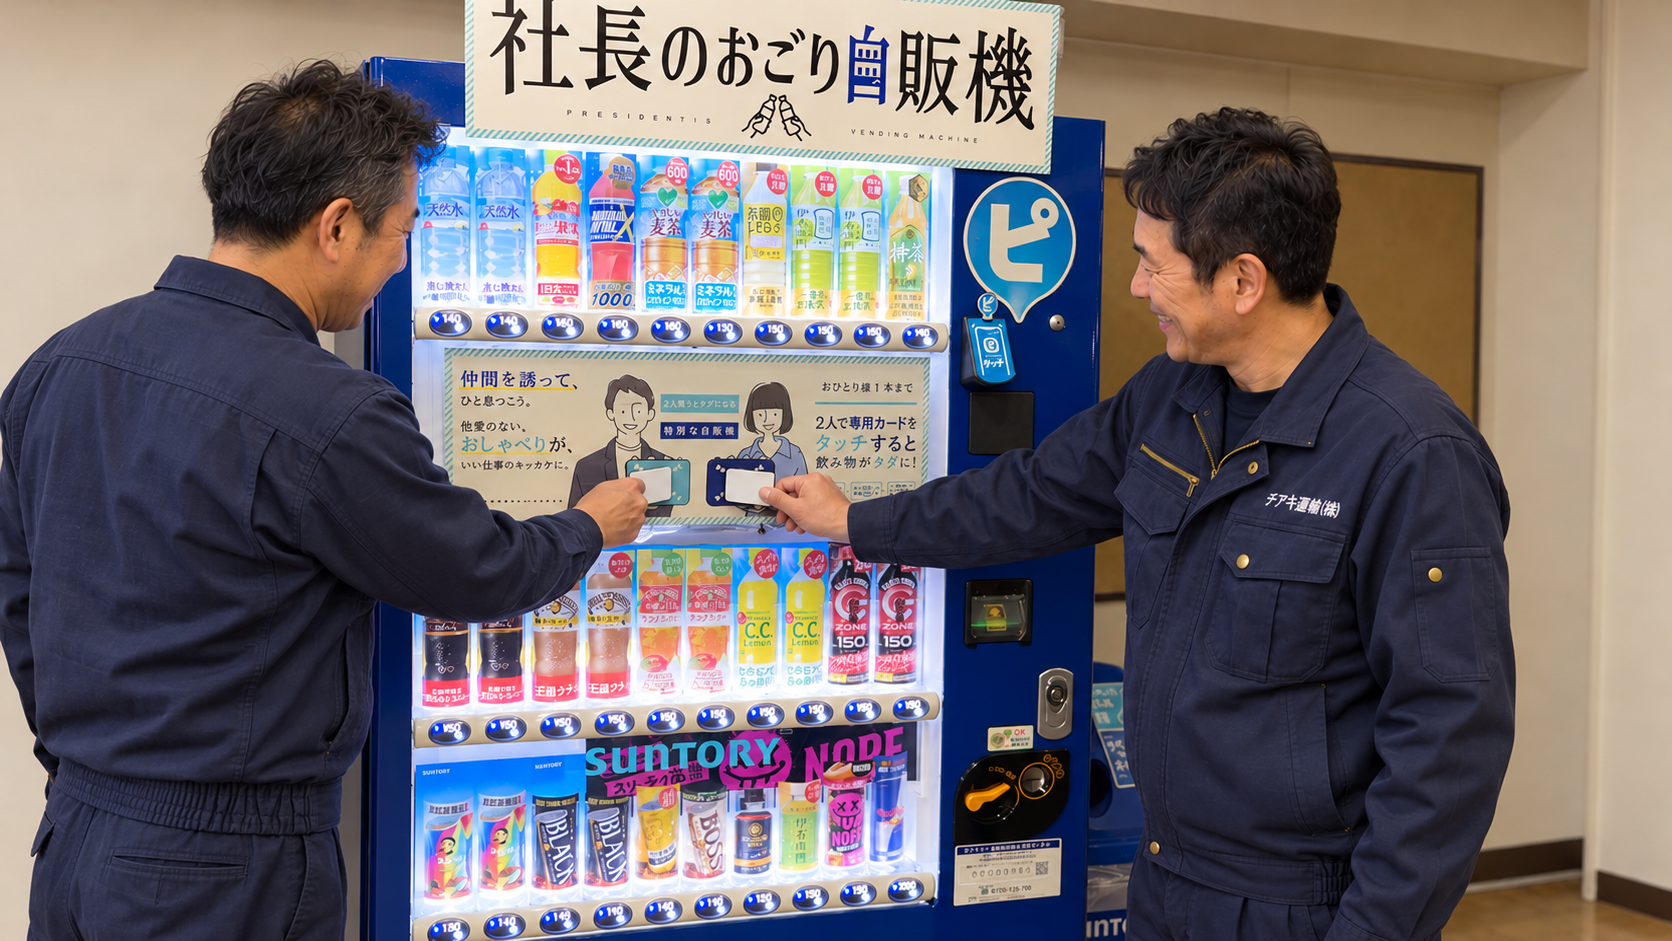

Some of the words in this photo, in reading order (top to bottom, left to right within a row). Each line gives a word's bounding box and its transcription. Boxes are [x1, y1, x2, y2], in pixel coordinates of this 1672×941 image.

[489, 0, 1035, 131] 社長のおごり自販機
[851, 129, 909, 139] VENDING
[918, 133, 978, 144] MACHINE
[667, 166, 688, 179] 600
[718, 169, 738, 182] 600
[427, 202, 464, 217] 天然水
[484, 204, 520, 219] 天然水
[649, 217, 682, 236] 麦茶
[699, 219, 732, 238] 麦茶
[592, 292, 632, 307] 1000
[460, 370, 578, 390] 仲間を誘って、
[460, 396, 531, 407] ひと息つこう。
[460, 421, 526, 432] 他愛のない。
[815, 416, 917, 430] 2人で専用カードを
[816, 434, 916, 452] タッチすると
[461, 460, 569, 470] いい仕事のキッカケに。
[835, 623, 867, 631] ZONE
[882, 622, 914, 631] ZONE
[837, 636, 865, 648] 150
[883, 635, 912, 647] 150
